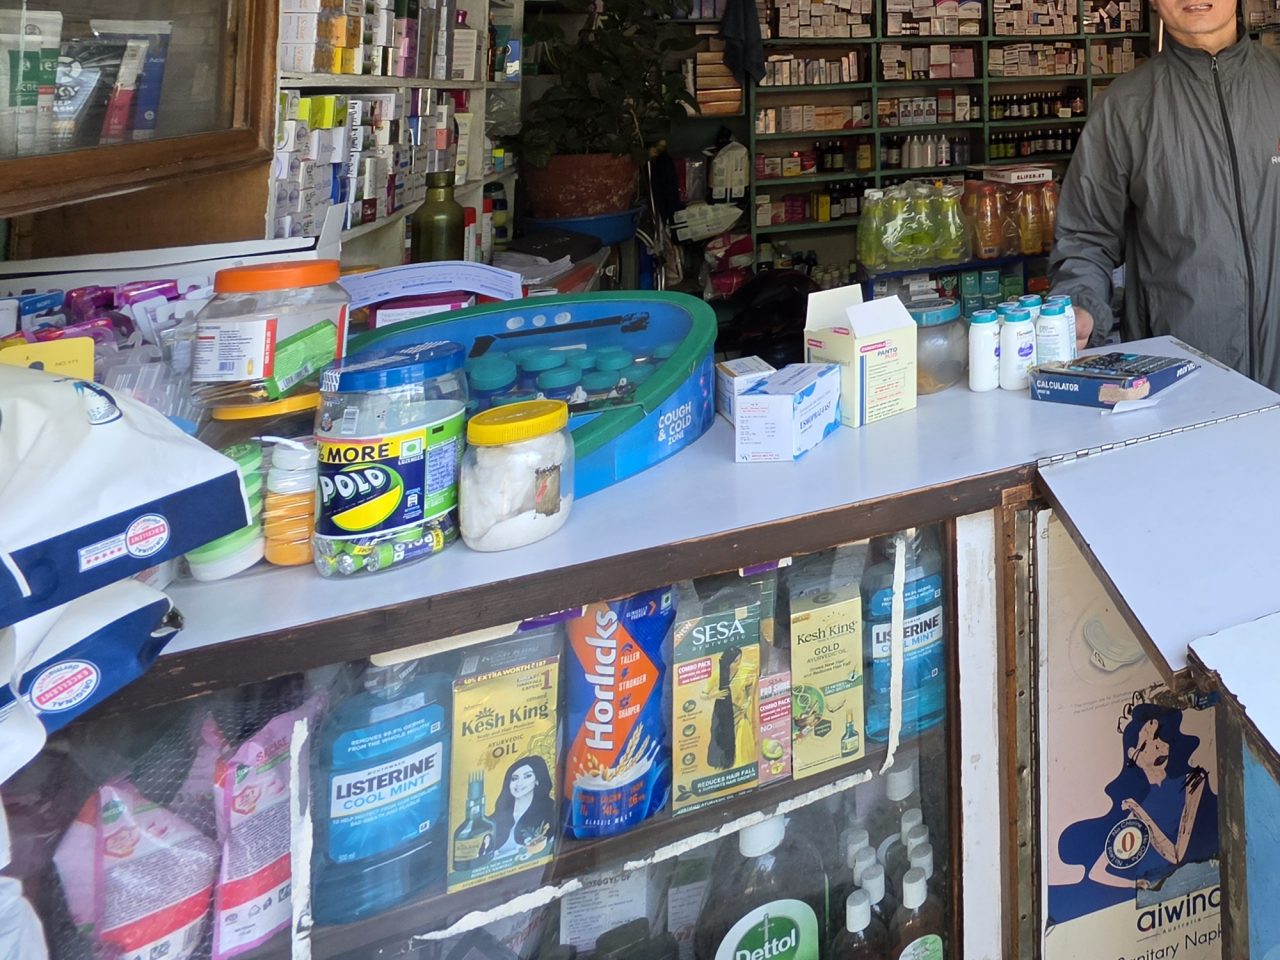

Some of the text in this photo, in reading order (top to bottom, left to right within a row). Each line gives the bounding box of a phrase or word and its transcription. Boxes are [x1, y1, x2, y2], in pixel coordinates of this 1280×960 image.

[877, 347, 898, 359] PANTO
[1036, 380, 1079, 392] CALCULATOR
[658, 402, 692, 429] COUGH
[658, 415, 692, 442] & COLD
[668, 433, 685, 446] ZONE
[327, 443, 390, 463] MORE
[320, 469, 386, 504] POLO
[130, 524, 166, 545] EXCELLENT
[134, 536, 165, 554] ORIGINAL
[676, 620, 693, 640] NEW
[692, 619, 746, 646] SESA
[797, 621, 856, 646] Kesh King
[875, 614, 941, 645] LISERINE
[911, 630, 936, 646] MINT
[620, 651, 640, 665] TALLER
[814, 642, 841, 656] GOLD
[477, 665, 530, 683] EXTRA WORTH
[585, 610, 618, 751] Horlicks
[618, 673, 647, 692] STRONGER
[38, 666, 93, 705] EXCELLENT
[51, 678, 94, 708] ORIGINAL
[462, 701, 549, 738] Kesh King
[618, 704, 641, 720] SHARPER
[347, 742, 367, 753] FROM
[367, 739, 381, 749] THE
[488, 734, 525, 749] AYURVEDIC
[492, 743, 519, 760] OIL
[336, 752, 438, 801] LISTERINE
[697, 767, 756, 789] REDUCES HAIR FALL
[343, 775, 426, 811] COOL MINT
[1111, 827, 1121, 837] No
[1121, 831, 1135, 853] 0
[1162, 917, 1202, 934] Australia
[735, 928, 797, 960] Dettol
